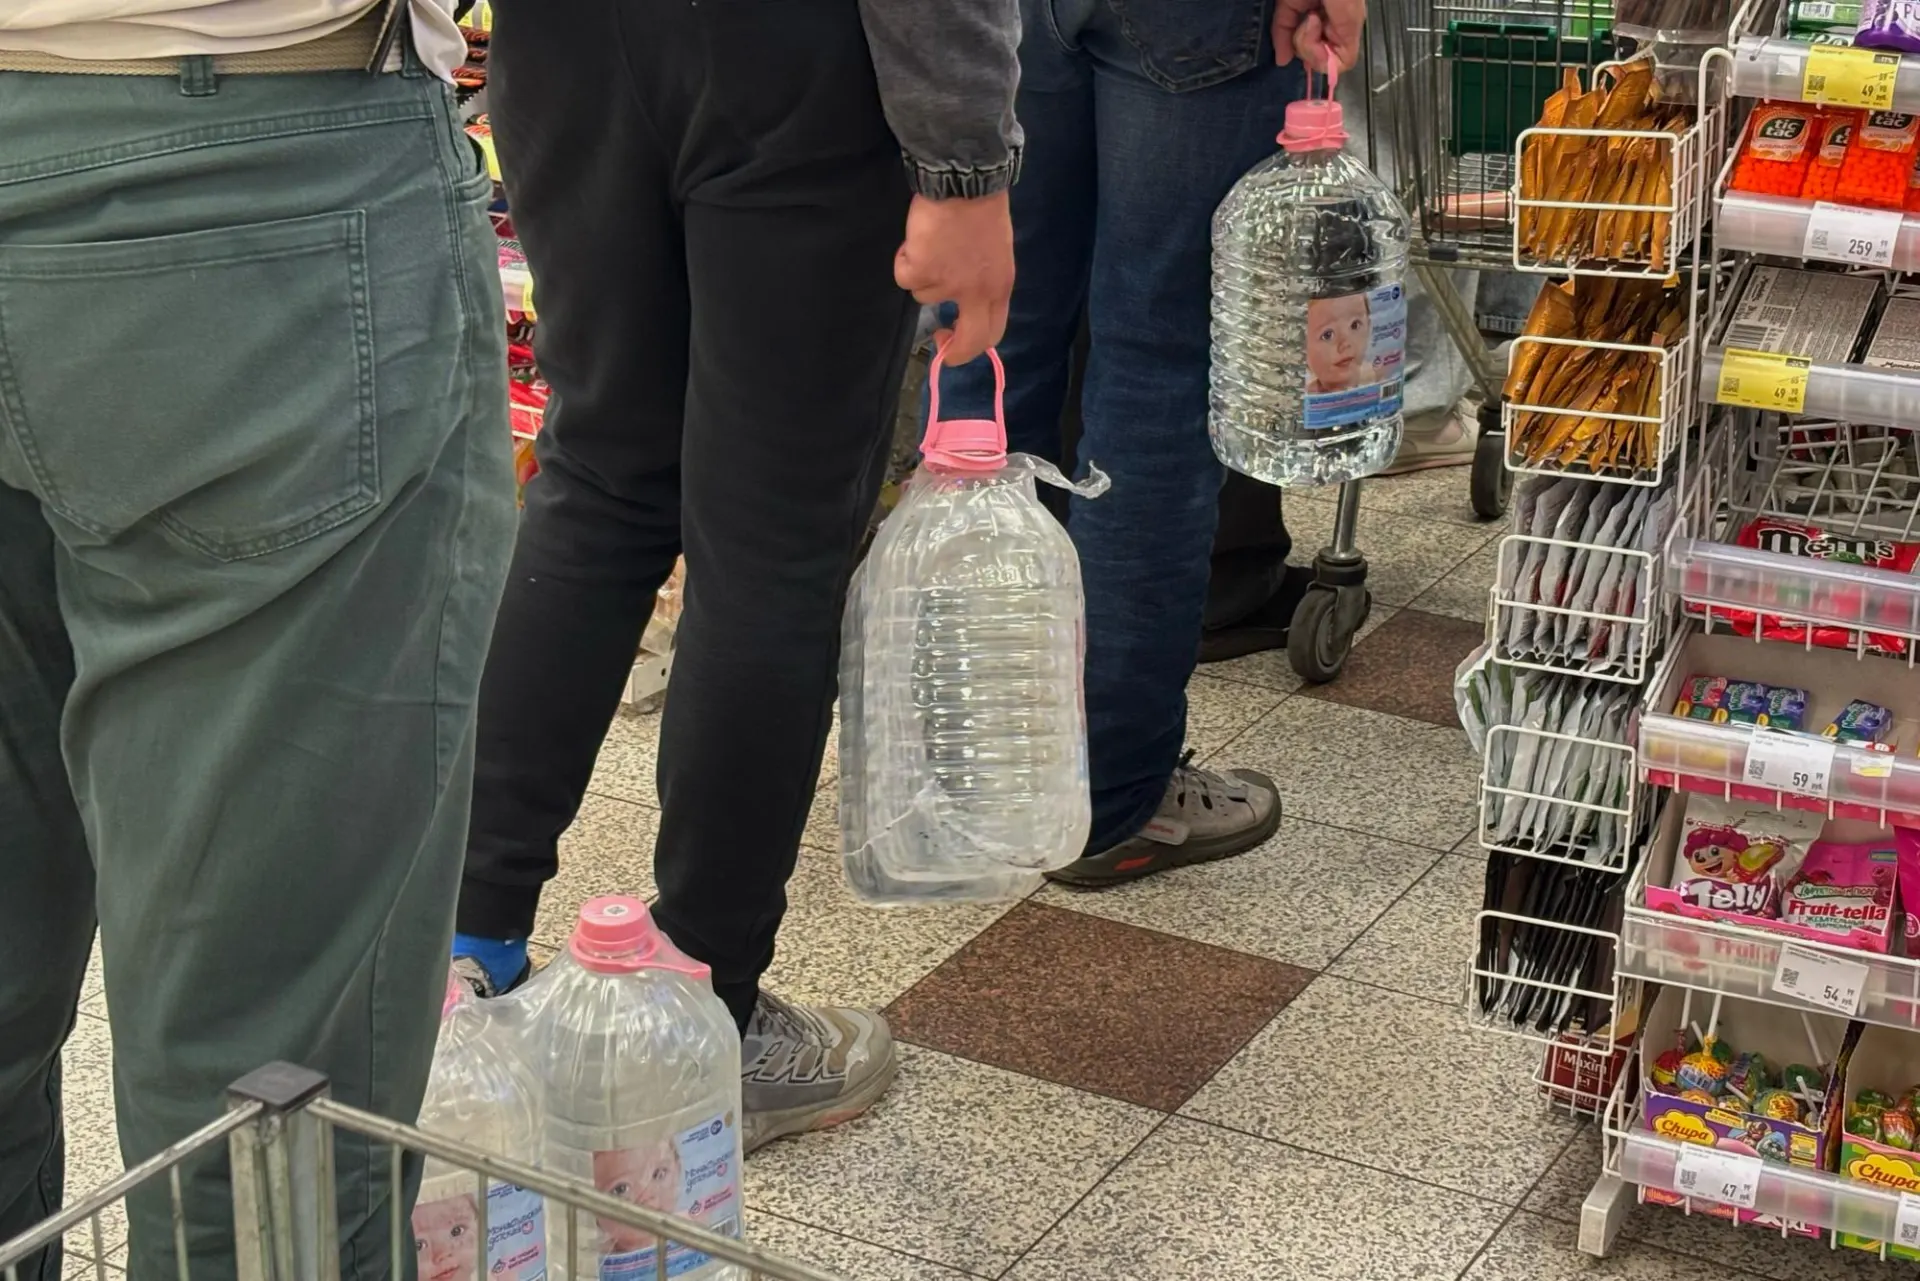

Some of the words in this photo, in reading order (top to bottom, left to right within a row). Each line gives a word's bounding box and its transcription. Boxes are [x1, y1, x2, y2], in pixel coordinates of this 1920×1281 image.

[1861, 84, 1874, 97] 49
[1774, 119, 1800, 130] tic
[1874, 115, 1905, 127] tac
[1765, 126, 1795, 138] tac
[1848, 238, 1873, 257] 259
[1774, 387, 1786, 399] 49
[1792, 771, 1809, 788] 59
[1788, 900, 1887, 920] Fruit-tella
[1823, 985, 1840, 1001] 54
[1662, 1119, 1709, 1141] Chupa
[1858, 1163, 1920, 1190] Chupa
[1721, 1183, 1737, 1198] 47
